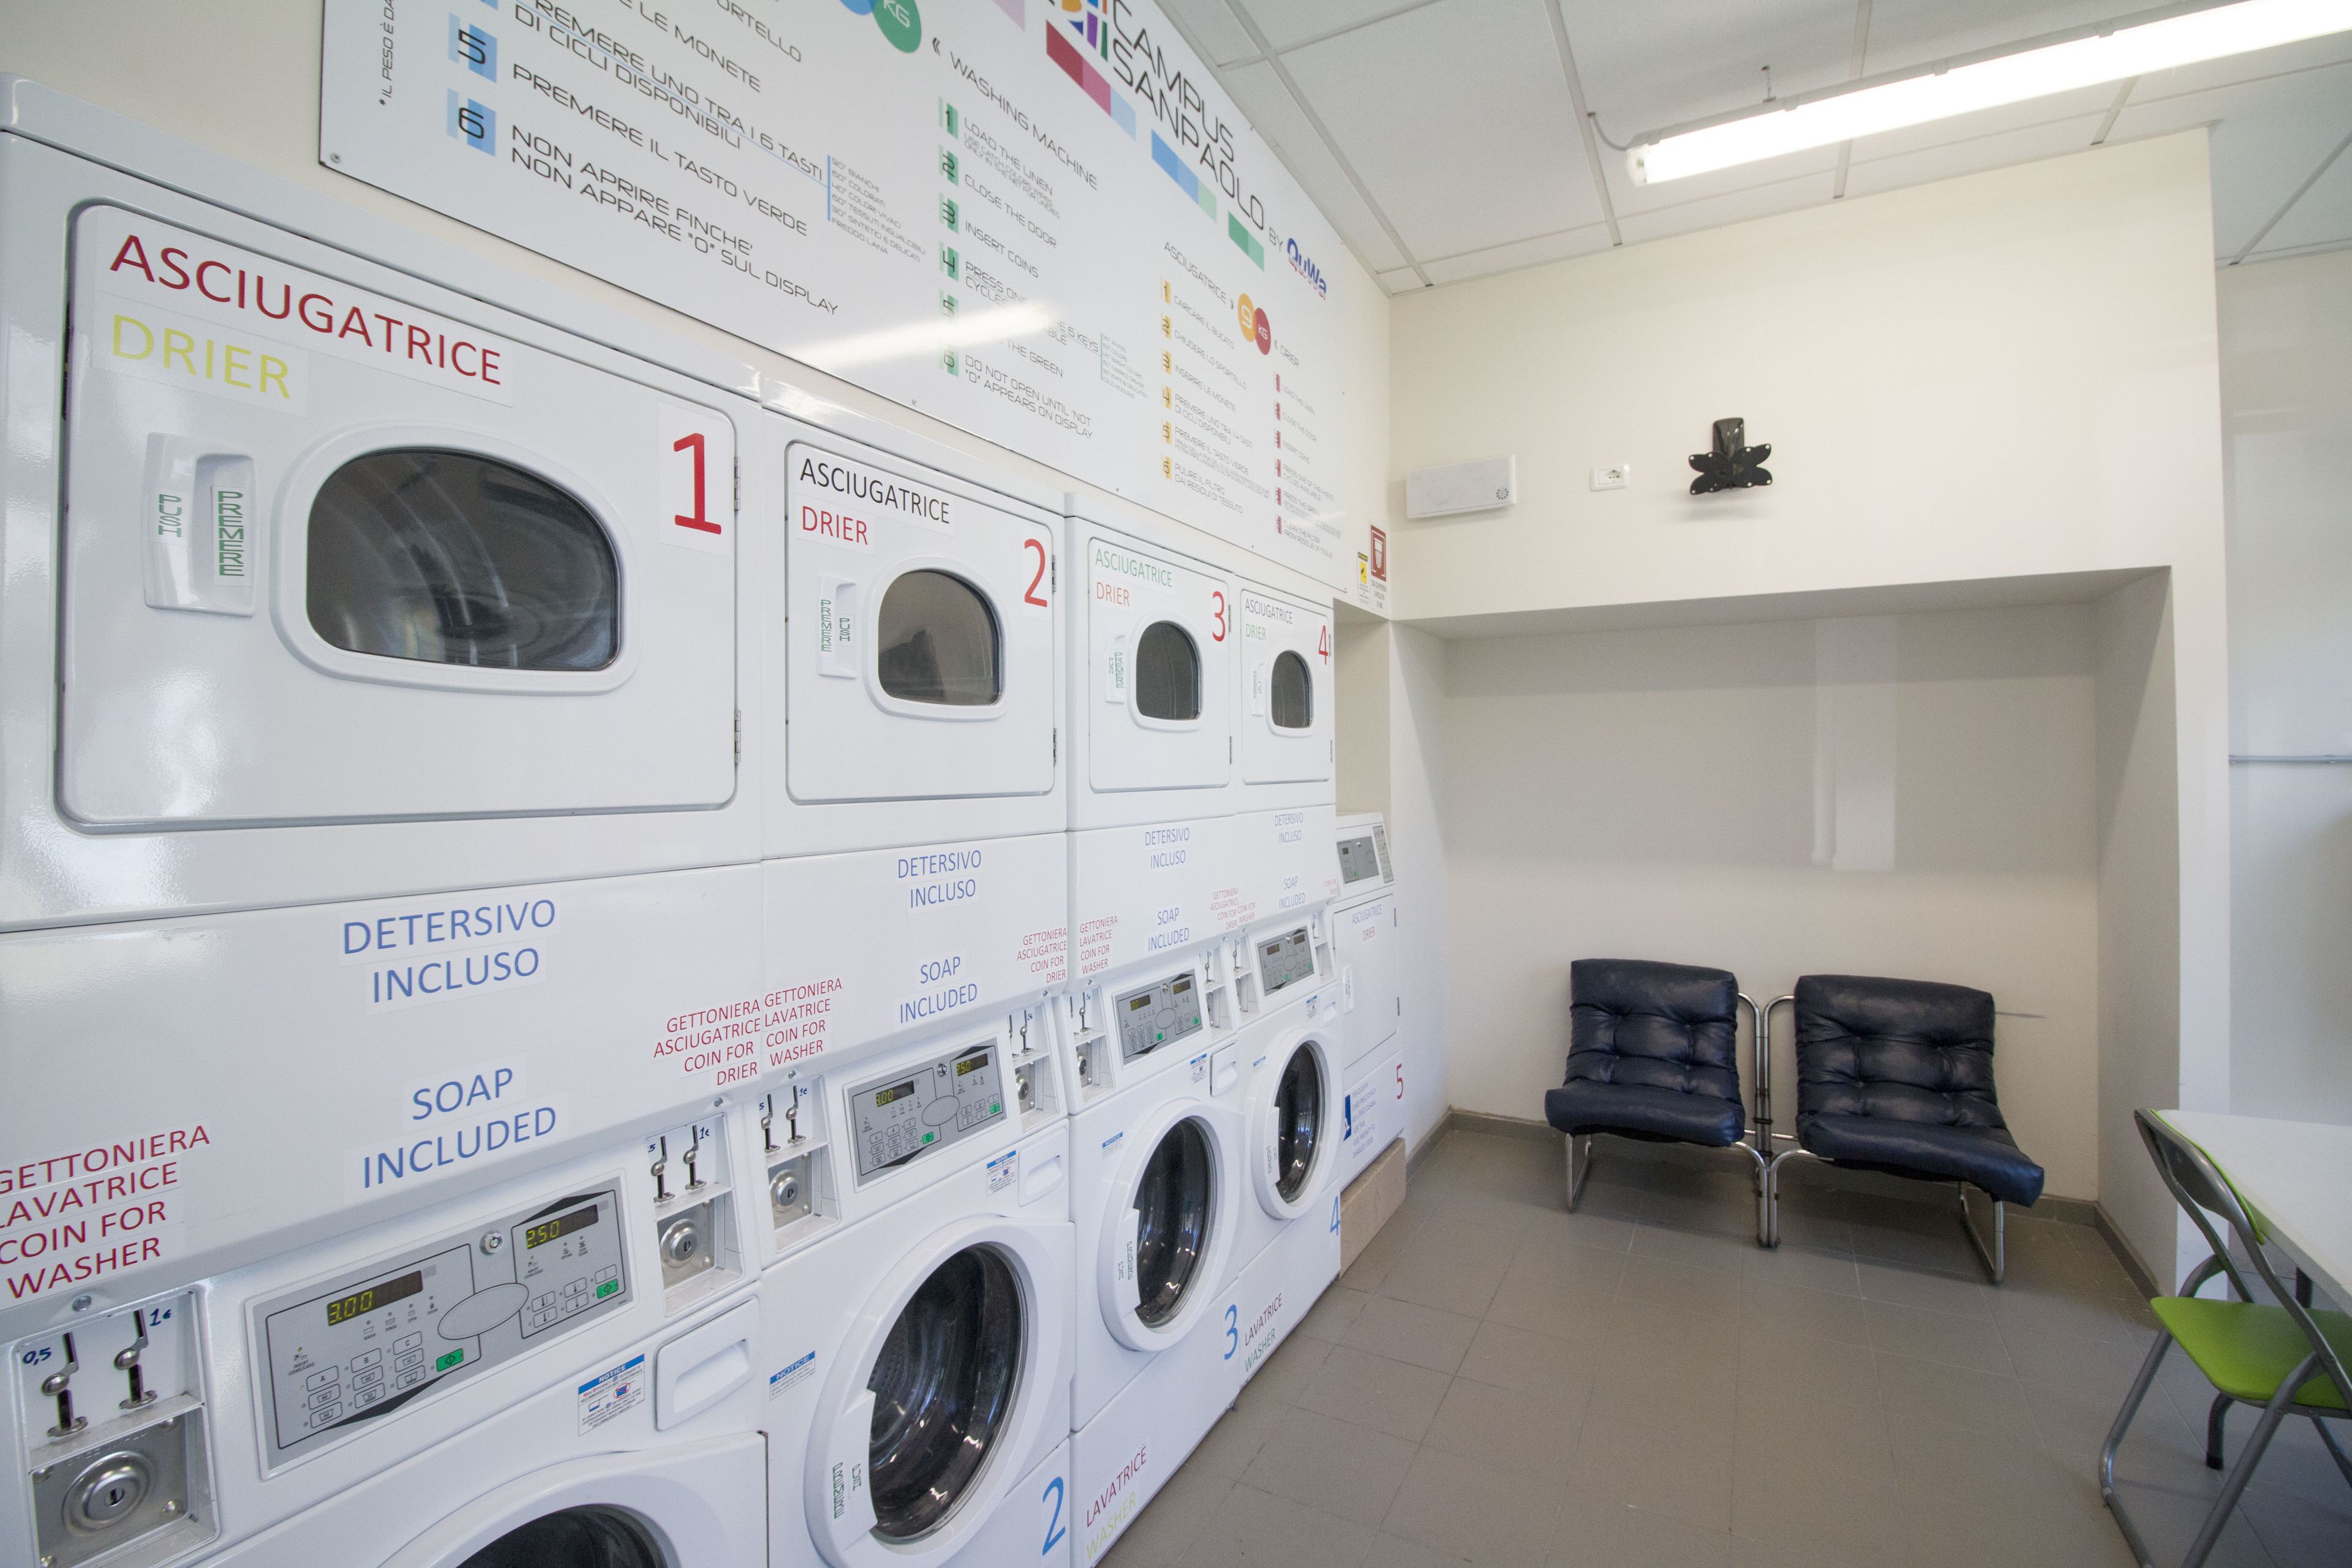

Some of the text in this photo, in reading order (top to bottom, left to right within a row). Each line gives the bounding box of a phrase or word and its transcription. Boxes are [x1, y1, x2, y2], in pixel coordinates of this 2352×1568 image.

[883, 0, 910, 28] KG
[382, 37, 393, 81] PESO
[458, 29, 486, 64] 5
[640, 1, 760, 92] LE MONETE
[516, 4, 740, 149] DI CICLI DISPONIBILI
[536, 0, 822, 181] REMERE UNO TRA 6 TASTI
[1113, 0, 1234, 162] CAMPUS
[459, 107, 484, 139] 6
[951, 51, 1028, 130] WASHING
[1033, 124, 1097, 190] MACHINE
[514, 63, 808, 236] PREMERE IL TASTO VERDE
[965, 117, 996, 151] LOAD
[1000, 145, 1020, 170] THE
[1023, 165, 1052, 195] LINEN
[1112, 39, 1283, 252] SANPAOLO BY
[512, 125, 571, 167] NON
[580, 163, 669, 216] APRIRE
[943, 154, 954, 178] 2
[512, 148, 838, 315] NON APPARE SUL DISPLAY
[943, 202, 955, 224] 3
[965, 175, 1057, 248] CLOSE THE DOOR
[867, 238, 888, 255] LANA
[943, 251, 955, 273] 4
[965, 221, 1038, 278] INSERT COINS
[965, 262, 1003, 293] PRESS
[1164, 242, 1226, 304] ASCIUGATRICE
[110, 235, 501, 385] ASCIUGATRICE
[112, 314, 290, 399] DRIER
[1068, 327, 1075, 337] 6
[1077, 332, 1098, 352] KEYS
[1030, 352, 1063, 377] GREEN
[965, 355, 1069, 417] DO NOT OPEN UNTIL
[984, 380, 1092, 439] APPEARS ON DISPLAY
[673, 432, 722, 535] 1
[800, 458, 949, 524] ASCIUGATRICE
[159, 494, 181, 537] PUSH
[218, 491, 244, 576] PREMERE
[802, 505, 868, 545] DRIER
[1023, 538, 1047, 608] 2
[1095, 548, 1172, 588] ASCIUGATRICE
[1096, 581, 1130, 607] DRIER
[1245, 598, 1293, 625] ASCIUGATRICE
[821, 599, 832, 652] PREMERE
[839, 617, 850, 642] PUSH
[1212, 591, 1225, 642] 3
[1245, 624, 1266, 641] DRIER
[1318, 625, 1329, 665] 4
[1145, 827, 1189, 846] DETERSIVO
[1275, 812, 1303, 826] DETERSIVO
[1278, 830, 1301, 843] INCLUSO
[898, 850, 981, 878] DETERSIVO
[1150, 850, 1186, 869] INCLUSO
[911, 879, 976, 908] INCLUSO
[1278, 892, 1305, 910] INCLUDED
[1284, 876, 1298, 889] SOAP
[344, 899, 556, 955] DETERSIVO
[1080, 916, 1118, 933] GETTONIERA
[1157, 907, 1179, 925] SOAP
[1017, 941, 1067, 961] ASCIUGATRICE
[1023, 927, 1067, 946] GETTONIERA
[1079, 930, 1112, 947] LAVATRICE
[1080, 944, 1110, 961] COIN FOR
[1148, 927, 1189, 952] INCLUDED
[373, 948, 539, 1003] INCLUSO
[920, 956, 960, 984] SOAP
[1031, 956, 1063, 973] COIN FOR
[1046, 970, 1066, 983] DRIER
[1082, 959, 1108, 974] WASHER
[764, 978, 842, 1008] GETTONIERA
[765, 998, 831, 1027] LAVATRICE
[900, 982, 977, 1023] INCLUDED
[666, 999, 760, 1033] GETTONIERA
[766, 1019, 826, 1047] COIN FOR
[654, 1018, 761, 1058] ASCIUGATRICE
[684, 1041, 754, 1072] COIN FOR
[770, 1039, 823, 1066] WASHER
[717, 1061, 757, 1085] DRIER
[1396, 1063, 1403, 1099] 5
[412, 1068, 513, 1121] SOAP
[0, 1125, 210, 1195] GETTONIERA
[364, 1106, 556, 1188] INCLUDED
[0, 1162, 178, 1229] AVATRICE
[1330, 1196, 1340, 1235] 4
[0, 1201, 166, 1265] COIN FOR
[7, 1237, 160, 1299] WASHER
[1224, 1304, 1238, 1360] 3
[1245, 1292, 1282, 1346] LAVATRICE
[776, 1355, 809, 1380] NOTICE
[1245, 1327, 1275, 1372] WASHER
[598, 1364, 626, 1382] NOTICE
[833, 1462, 845, 1520] PREMERE
[1087, 1445, 1146, 1528] LAVATRICE
[1042, 1477, 1065, 1556] 2
[1087, 1491, 1136, 1559] WASHER
